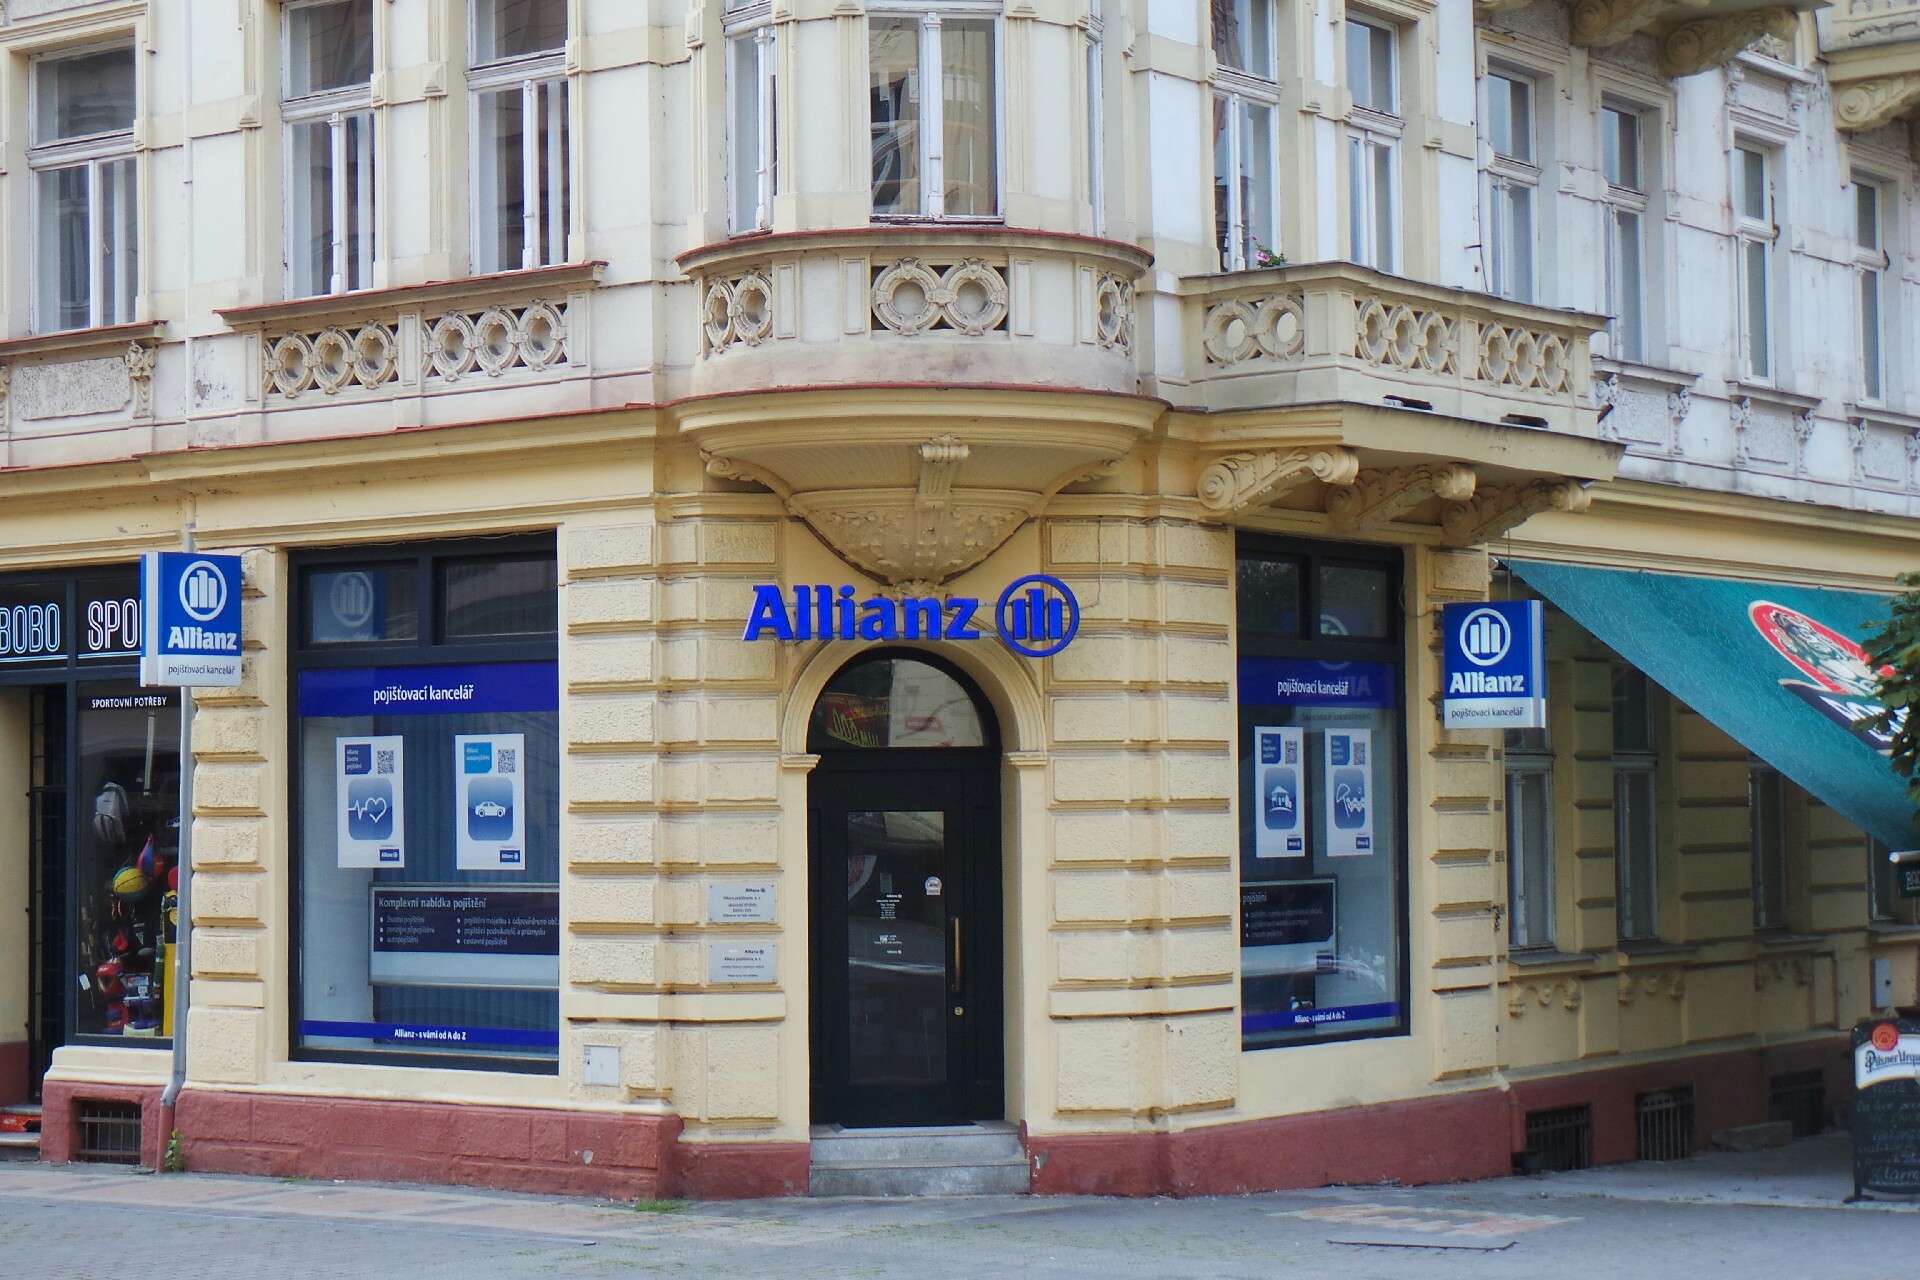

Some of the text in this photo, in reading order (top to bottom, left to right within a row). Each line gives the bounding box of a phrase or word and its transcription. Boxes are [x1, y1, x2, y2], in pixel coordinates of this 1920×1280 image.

[743, 584, 979, 640] Allianz
[88, 599, 141, 650] SPO
[168, 626, 238, 650] Allianz
[168, 664, 235, 675] pojišťovací kancelář
[1277, 678, 1317, 696] pojišťovací
[1317, 680, 1349, 696] kancelář
[1449, 671, 1524, 693] Allianz
[91, 695, 168, 708] SPORTOVNÍ POTŘEBY
[373, 684, 474, 705] pojišťovací kancelář
[1451, 706, 1523, 719] pojišťovací kancelář
[378, 897, 487, 911] Komplexní nabídka pojištění
[394, 1028, 415, 1038] Allianz
[423, 1030, 438, 1040] vámi
[438, 1030, 447, 1040] od
[447, 1031, 453, 1040] A
[453, 1031, 461, 1041] do
[461, 1031, 467, 1041] Z
[1865, 1050, 1898, 1073] Pilsner
